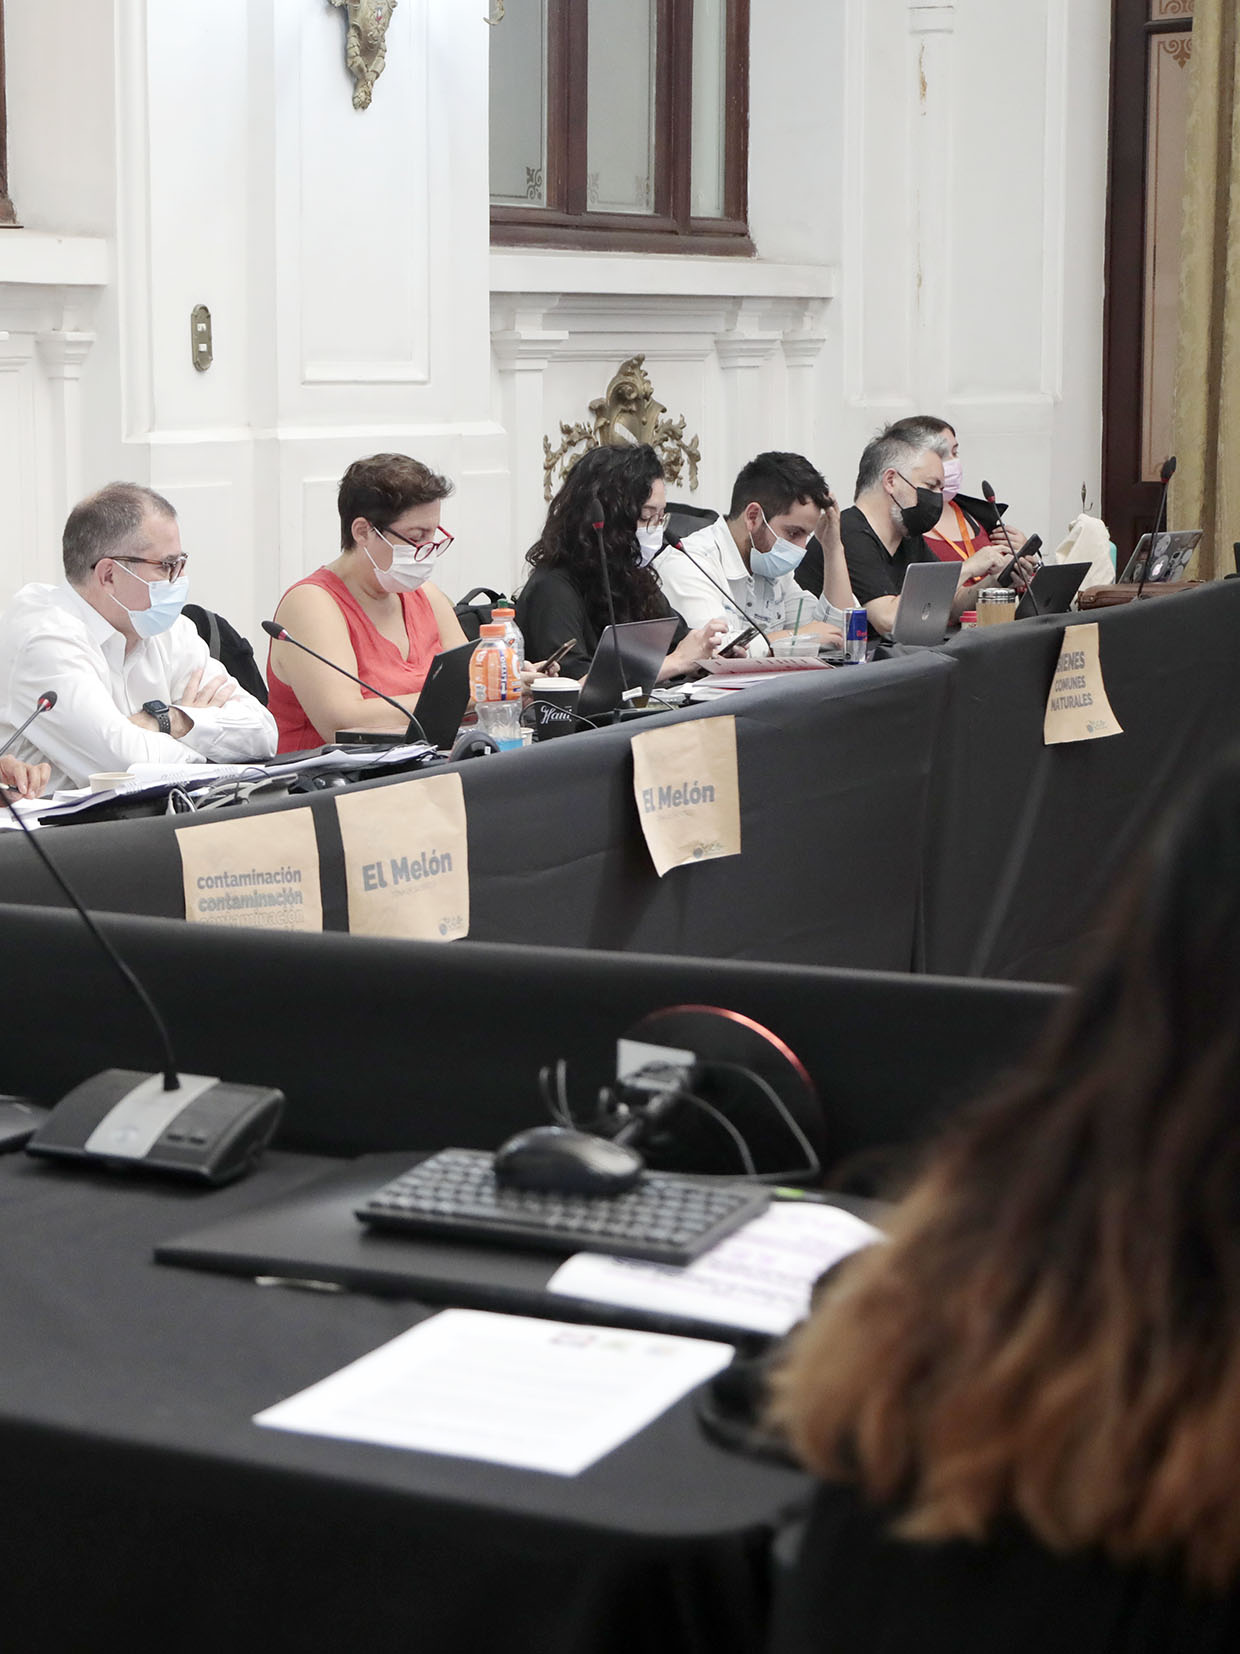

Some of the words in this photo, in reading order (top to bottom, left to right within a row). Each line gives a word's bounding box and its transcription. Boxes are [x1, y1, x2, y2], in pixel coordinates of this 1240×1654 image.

[1051, 693, 1093, 711] NATURALES
[642, 787, 656, 813] El
[657, 780, 716, 810] Melón
[196, 866, 302, 890] contaminación
[362, 861, 388, 892] El
[390, 849, 453, 886] Melón
[198, 887, 303, 912] contaminación
